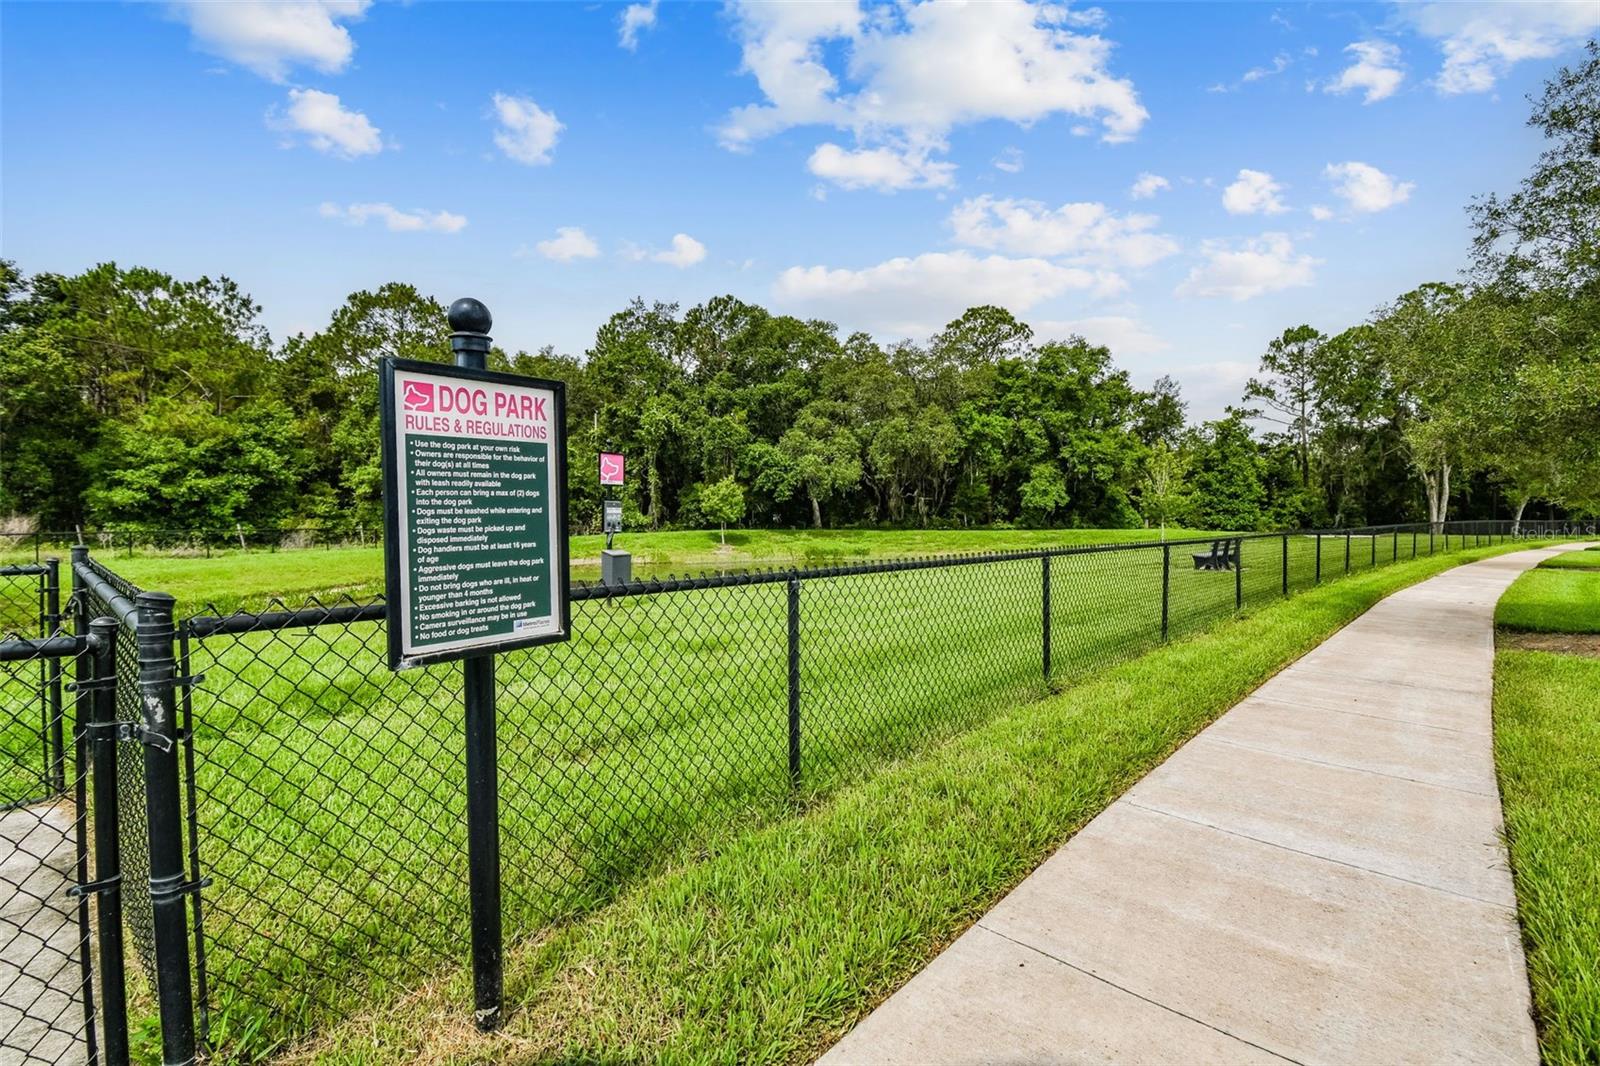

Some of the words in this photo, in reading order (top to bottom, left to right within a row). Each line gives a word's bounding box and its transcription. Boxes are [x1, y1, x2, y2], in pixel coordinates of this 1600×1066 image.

[439, 386, 487, 415] DOG
[495, 392, 547, 421] PARK
[405, 415, 449, 432] RULES
[454, 420, 462, 433] &
[466, 420, 547, 439] REGULATIONS
[442, 441, 456, 450] dog
[415, 450, 442, 458] Owners
[455, 452, 492, 460] responsible
[432, 460, 454, 469] dog(s)
[451, 480, 473, 488] readily
[473, 489, 489, 497] bring
[443, 498, 456, 506] dog
[416, 508, 435, 516] Dogs
[417, 527, 436, 535] Dogs
[484, 525, 505, 533] picked
[416, 536, 448, 545] disposed
[417, 546, 432, 554] Dog
[418, 564, 456, 574] Aggressive
[519, 558, 530, 566] dog
[532, 558, 544, 566] park
[418, 573, 459, 583] immediately
[443, 582, 461, 590] bring
[418, 593, 447, 603] younger
[469, 588, 493, 596] months
[419, 601, 454, 611] Excessive
[455, 599, 479, 607] barking
[498, 593, 522, 602] allowed
[431, 610, 460, 620] smoking
[477, 605, 499, 614] around
[510, 602, 522, 610] dog
[523, 601, 536, 609] park
[420, 621, 446, 630] Camera
[447, 616, 486, 627] surveillance
[431, 630, 447, 638] food
[457, 627, 470, 635] dog
[470, 624, 489, 632] treats
